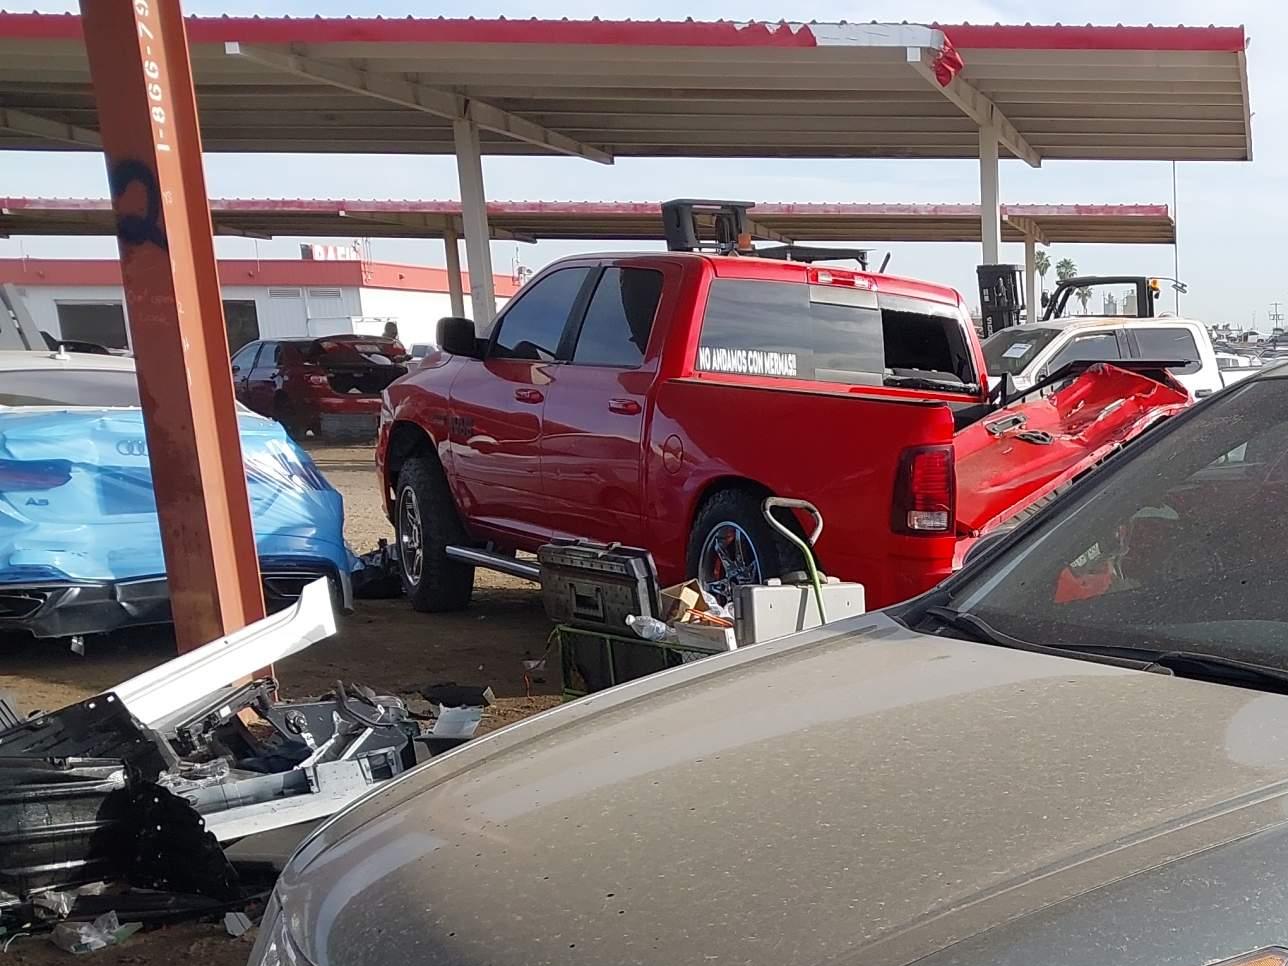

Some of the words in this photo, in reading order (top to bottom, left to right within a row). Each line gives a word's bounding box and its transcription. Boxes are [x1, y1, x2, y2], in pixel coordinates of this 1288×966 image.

[699, 346, 711, 371] NO
[712, 347, 747, 373] ANDAMOS
[748, 350, 763, 374] CON
